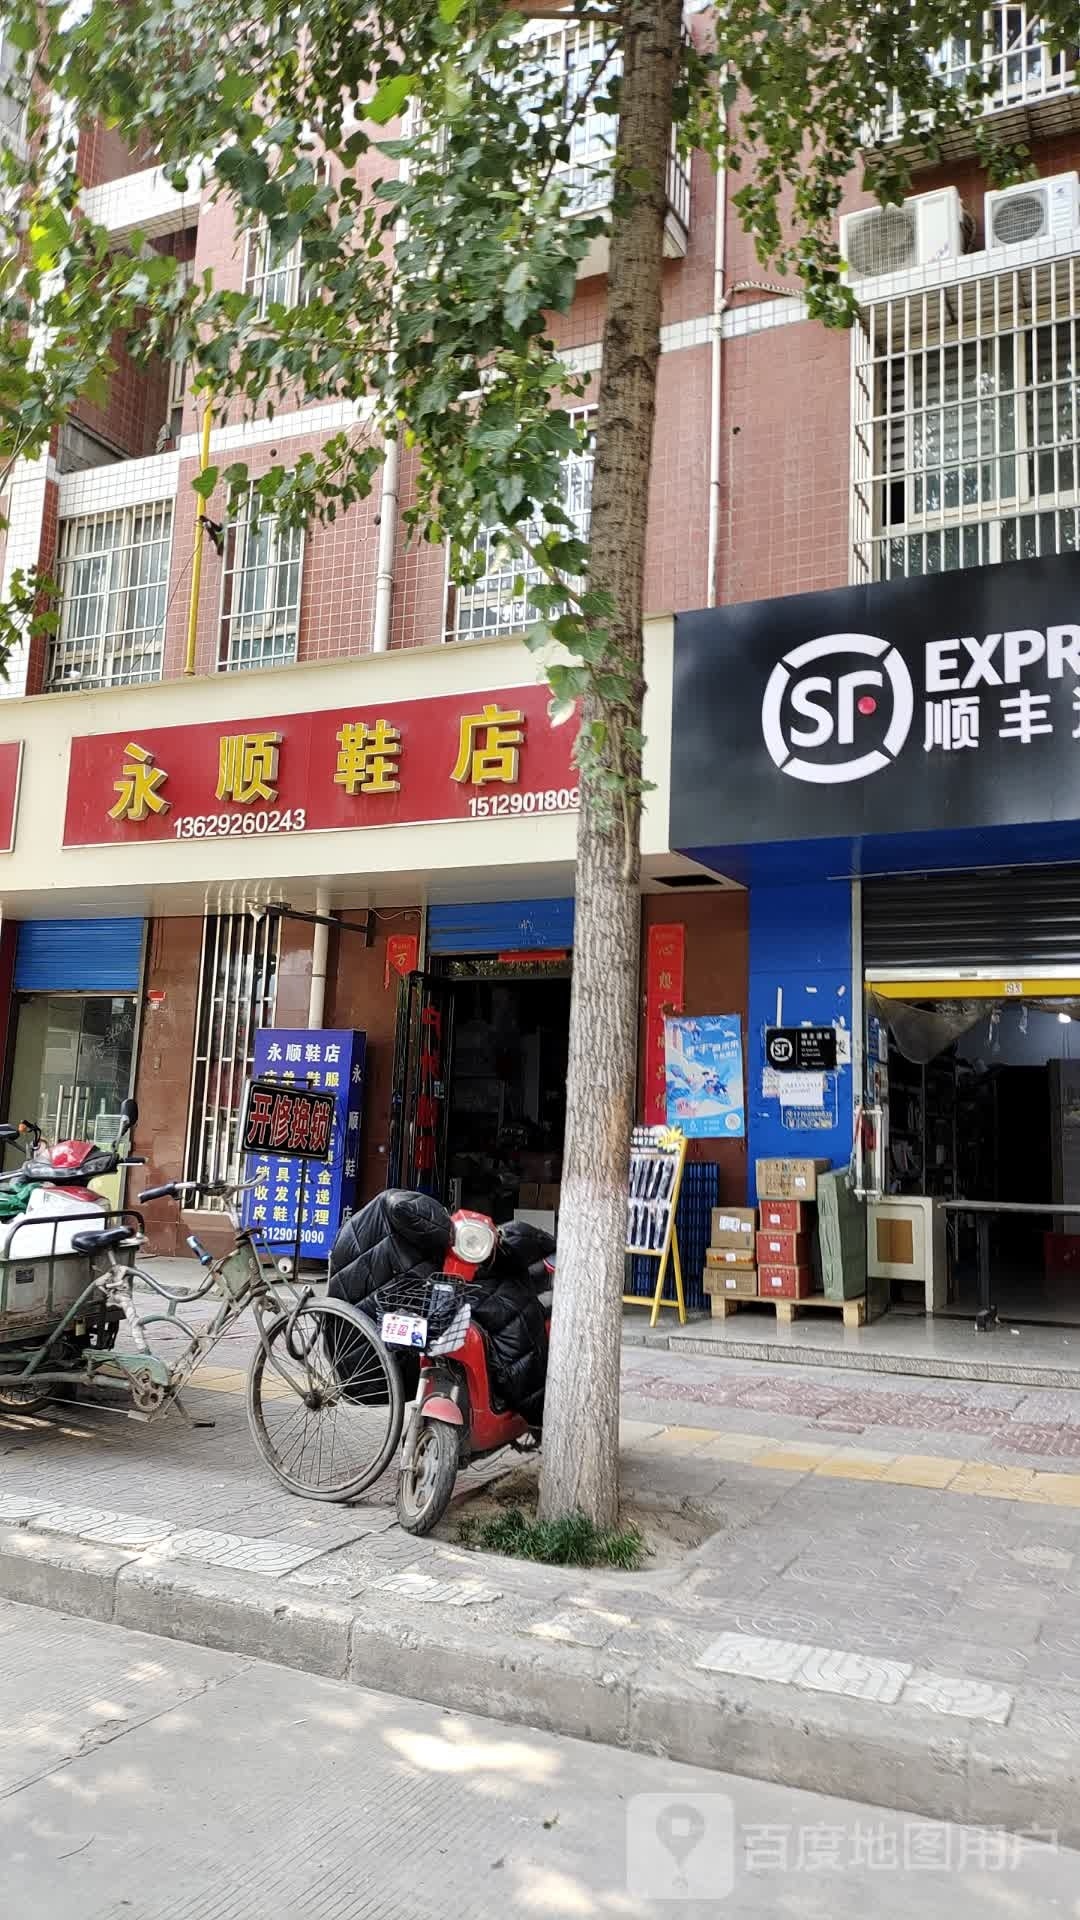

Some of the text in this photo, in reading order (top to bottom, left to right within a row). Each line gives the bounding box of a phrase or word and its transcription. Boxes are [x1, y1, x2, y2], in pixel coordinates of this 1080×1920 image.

[925, 624, 1080, 693] EXPR
[923, 689, 1080, 752] 顺丰
[108, 704, 525, 821] 永顺鞋店
[173, 808, 306, 839] 13629260243
[267, 1043, 341, 1064] 永顺鞋店
[248, 1093, 331, 1152] 开修换锁
[254, 1185, 330, 1205] 收发快递
[253, 1204, 330, 1226] 皮鞋修理
[256, 1226, 325, 1244] 5129018090
